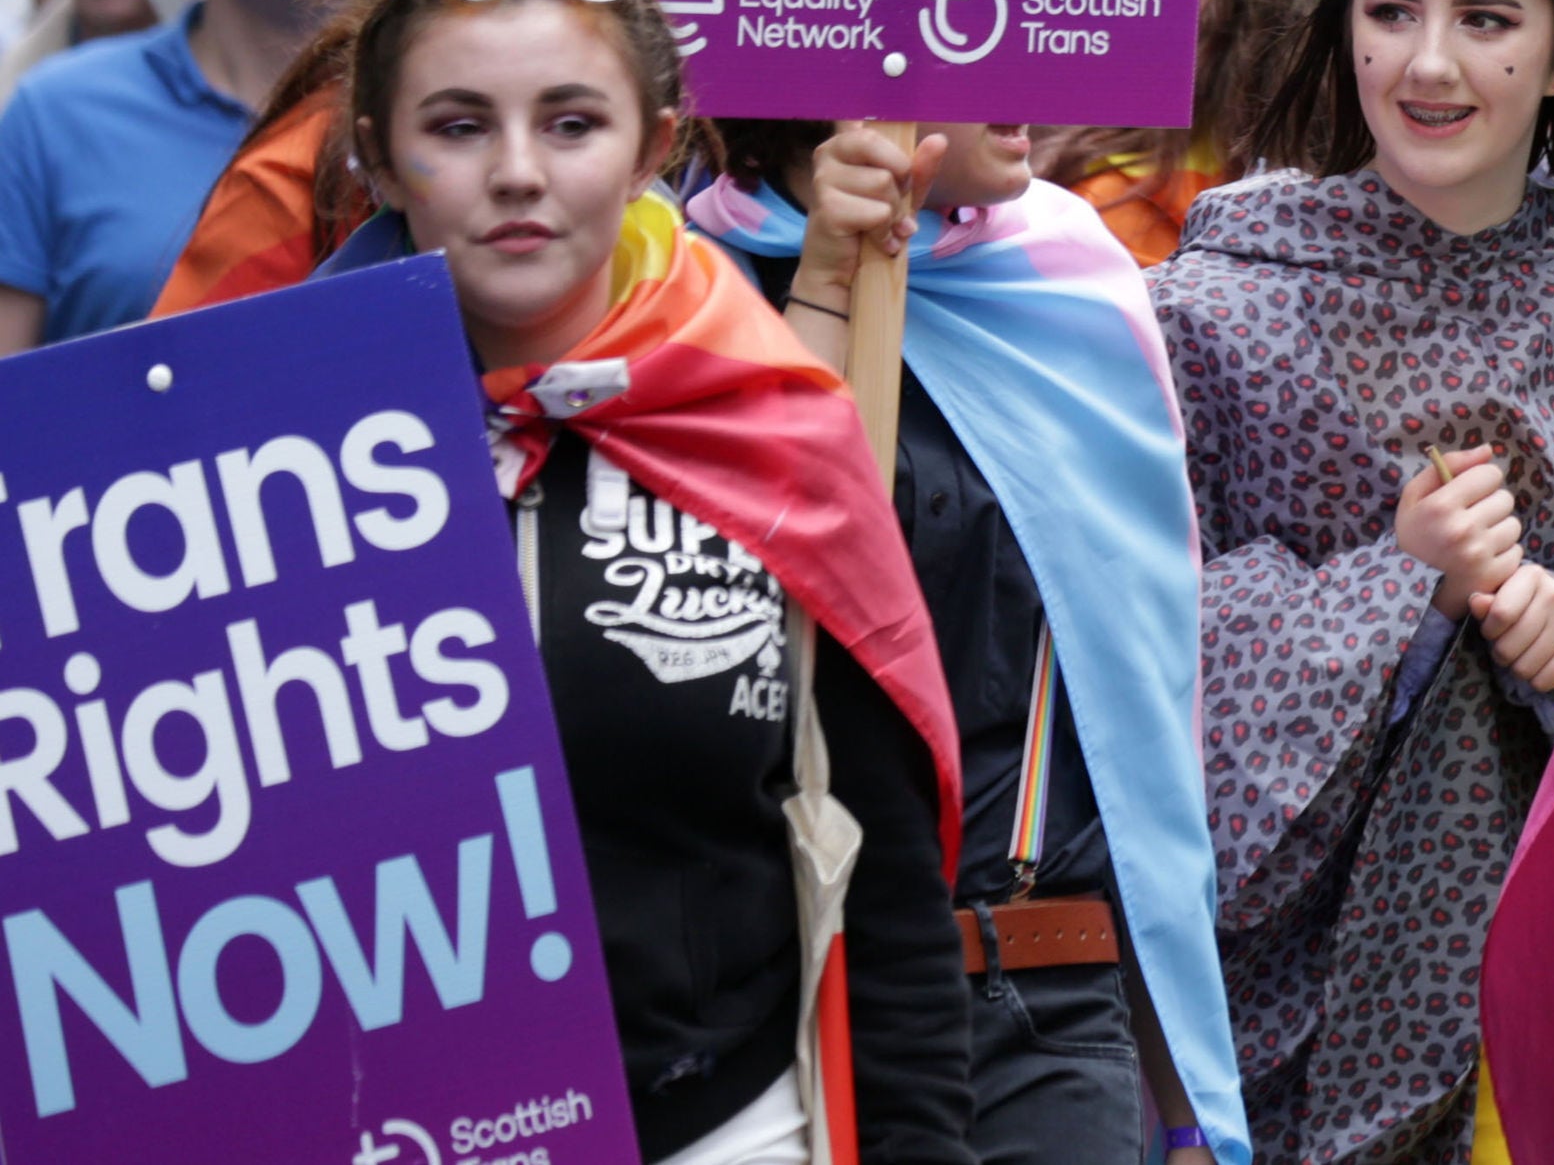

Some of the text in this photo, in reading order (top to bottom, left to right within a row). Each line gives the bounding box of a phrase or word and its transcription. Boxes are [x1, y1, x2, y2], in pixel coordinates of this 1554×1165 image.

[737, 14, 885, 51] Network
[1022, 21, 1111, 57] Trans
[0, 410, 450, 638] rans
[0, 599, 510, 867] Rights
[2, 765, 573, 1119] Now!
[451, 1087, 593, 1155] Scottish
